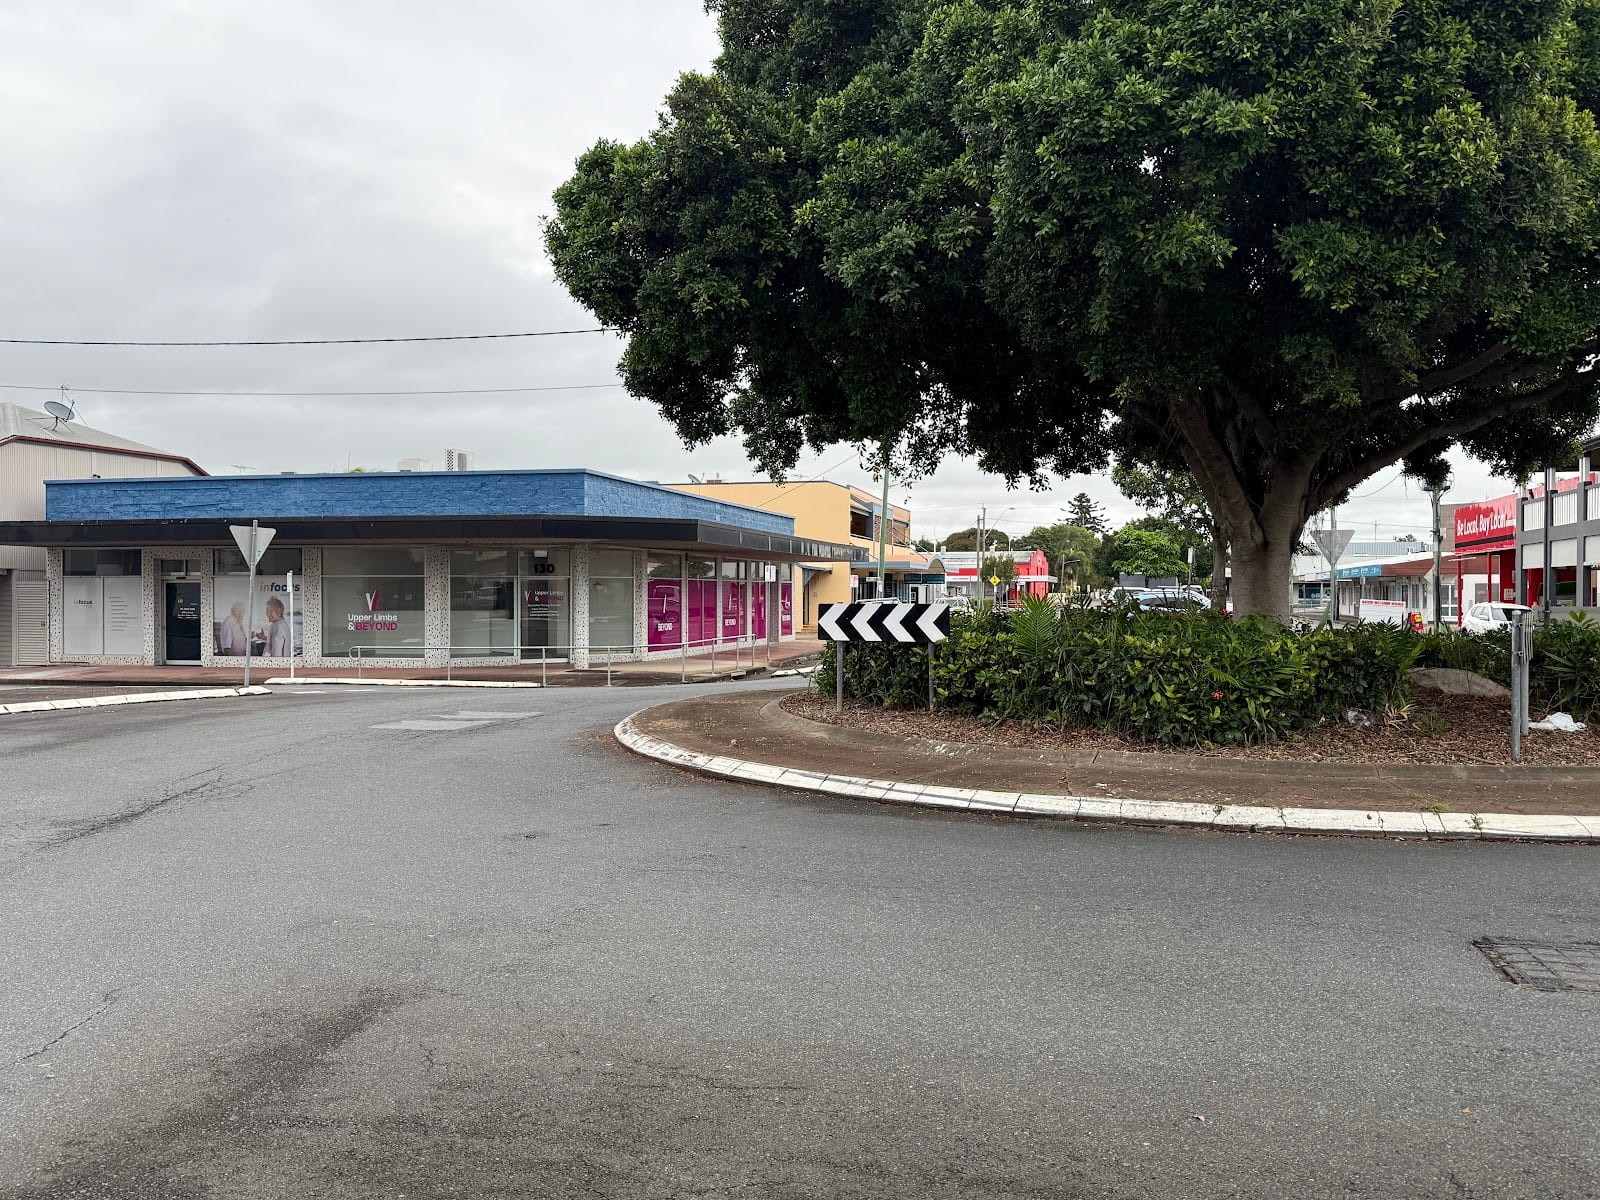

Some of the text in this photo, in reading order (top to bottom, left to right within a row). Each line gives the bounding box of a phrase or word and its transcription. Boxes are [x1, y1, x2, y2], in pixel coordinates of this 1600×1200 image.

[1456, 519, 1464, 537] Be
[1479, 514, 1490, 537] Buy
[534, 563, 555, 574] 130
[347, 613, 398, 622] Upper Limbs
